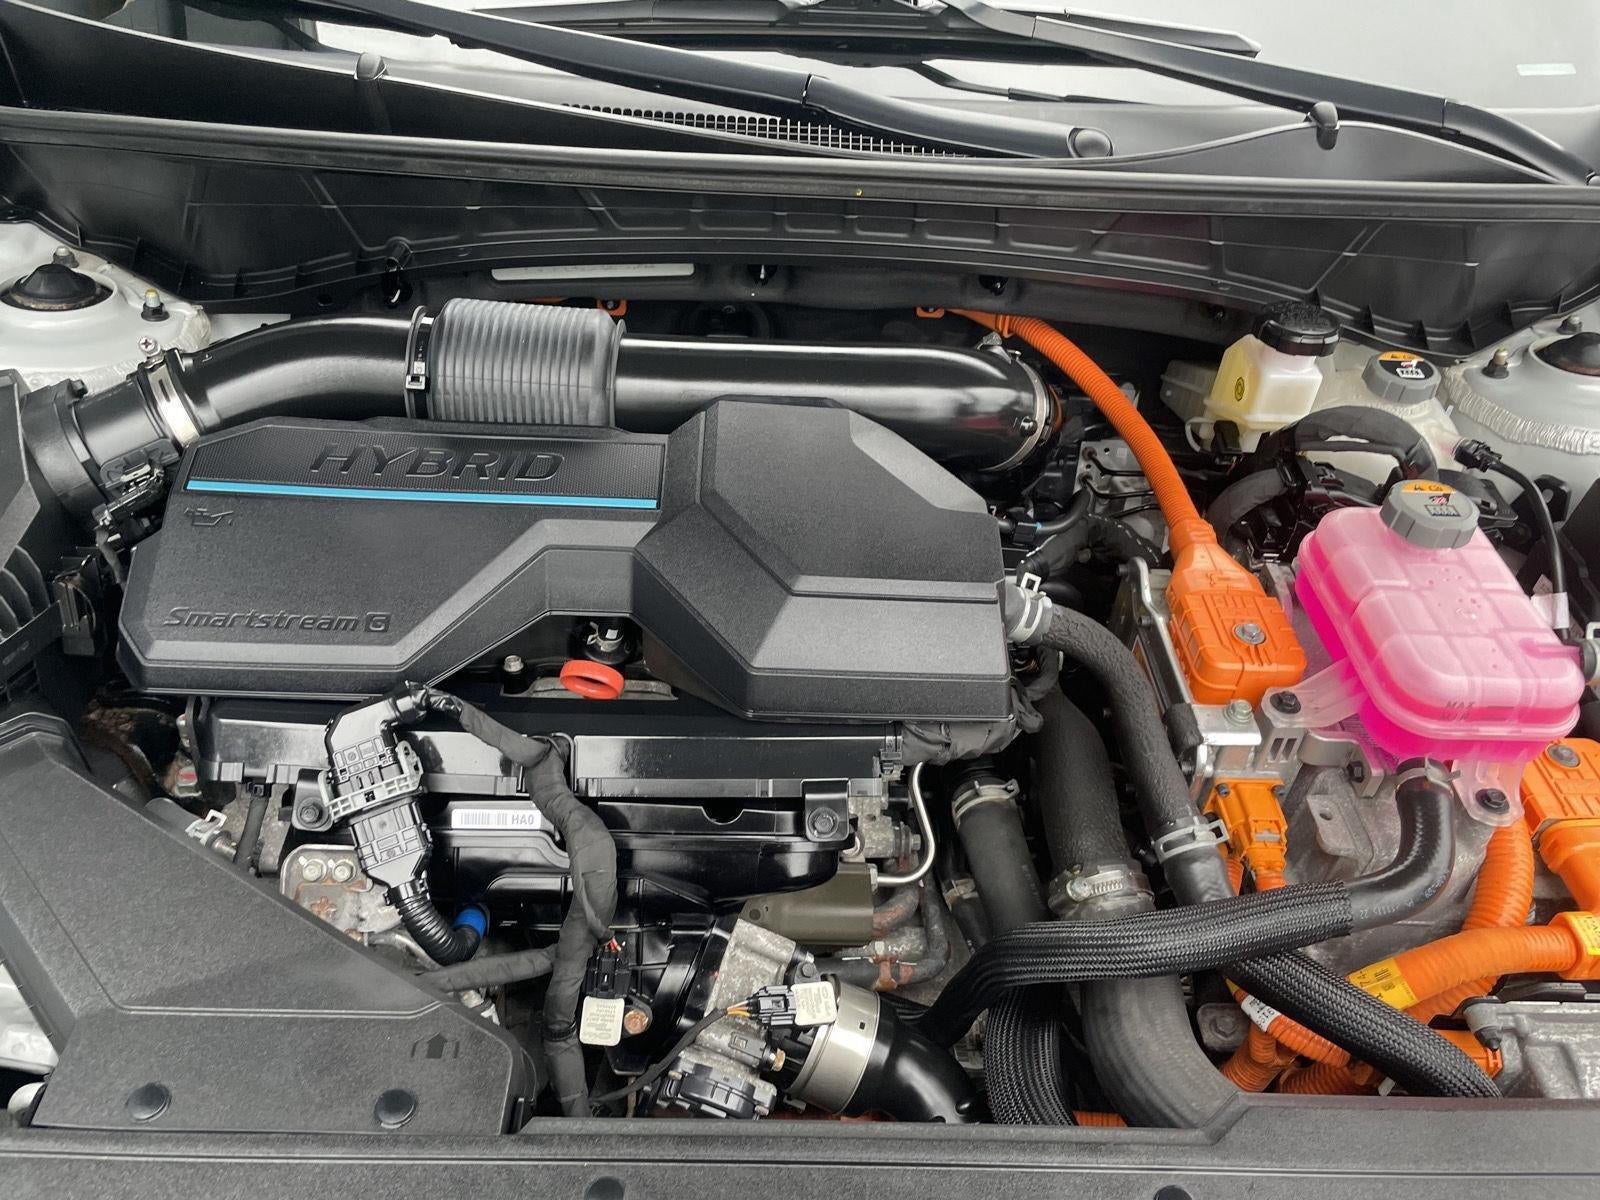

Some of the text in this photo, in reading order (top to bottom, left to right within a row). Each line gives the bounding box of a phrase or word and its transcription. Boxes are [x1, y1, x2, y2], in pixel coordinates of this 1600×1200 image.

[308, 442, 566, 482] HYBRID
[163, 606, 391, 633] Smartstream G
